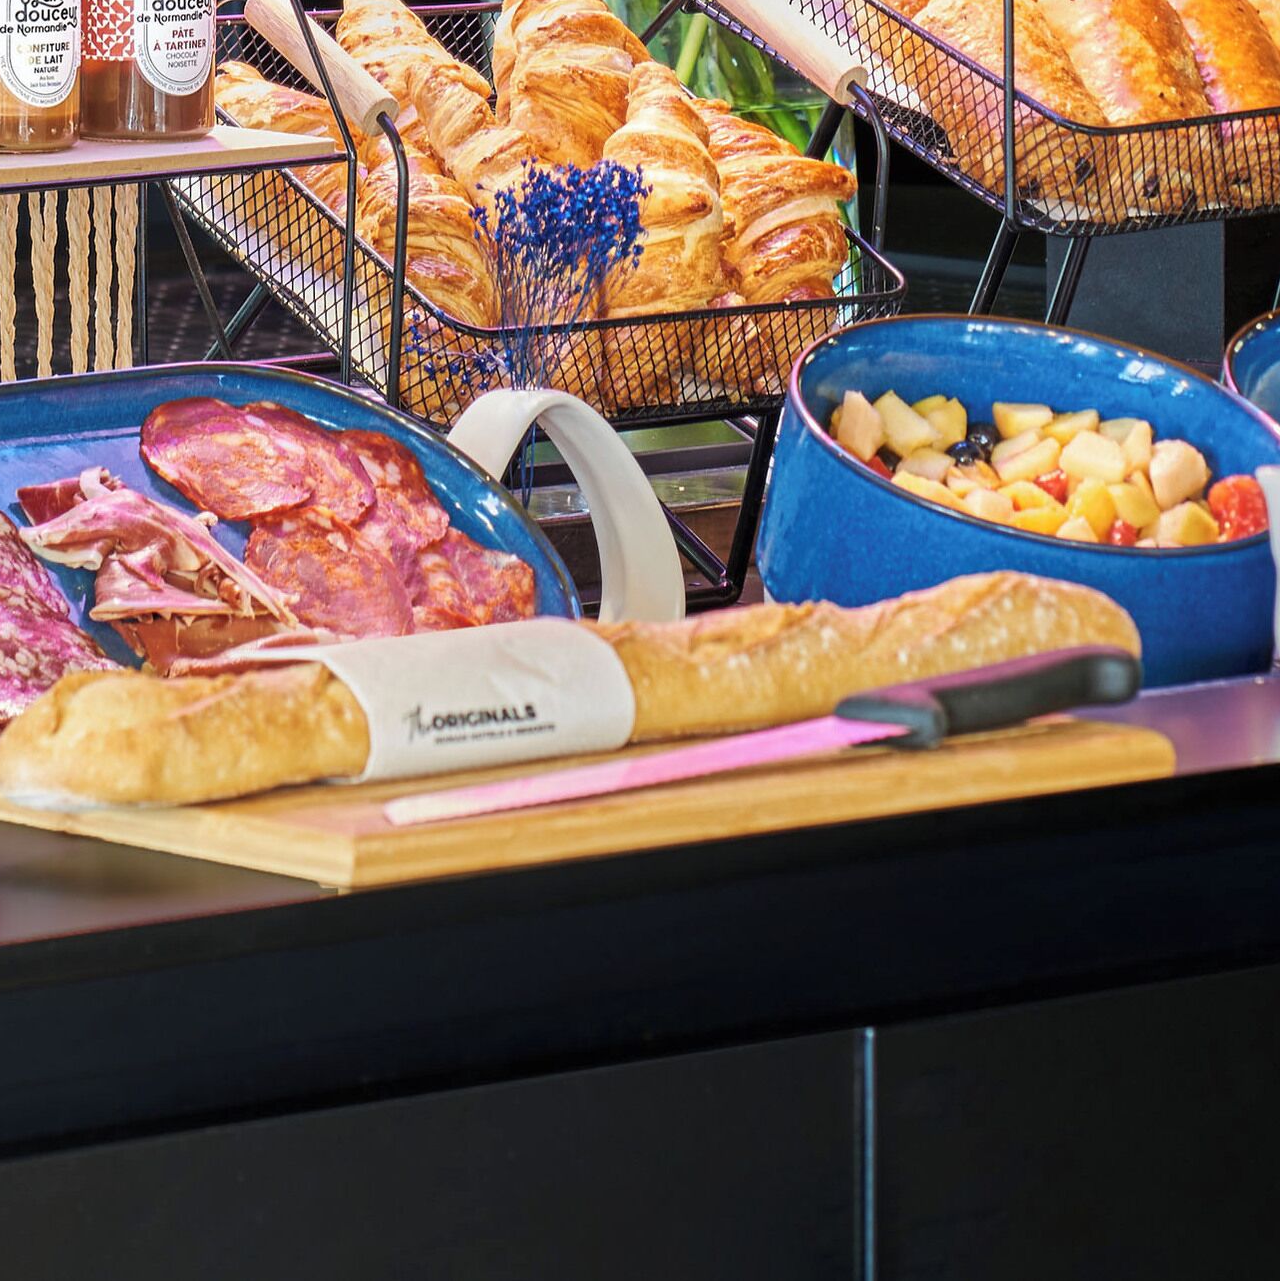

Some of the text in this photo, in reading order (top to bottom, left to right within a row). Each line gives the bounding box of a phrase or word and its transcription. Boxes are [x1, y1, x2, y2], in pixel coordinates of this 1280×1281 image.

[15, 2, 77, 27] douceur
[137, 11, 203, 25] de Normandie
[0, 22, 67, 37] de Normandie
[172, 27, 194, 38] PÂTE
[154, 39, 206, 51] À TARTINER
[44, 54, 64, 64] LAIT
[166, 51, 198, 59] CHOCOLAT
[168, 60, 197, 68] NOISETTE
[34, 66, 59, 74] NATURE
[432, 703, 537, 730] ORIGINALS
